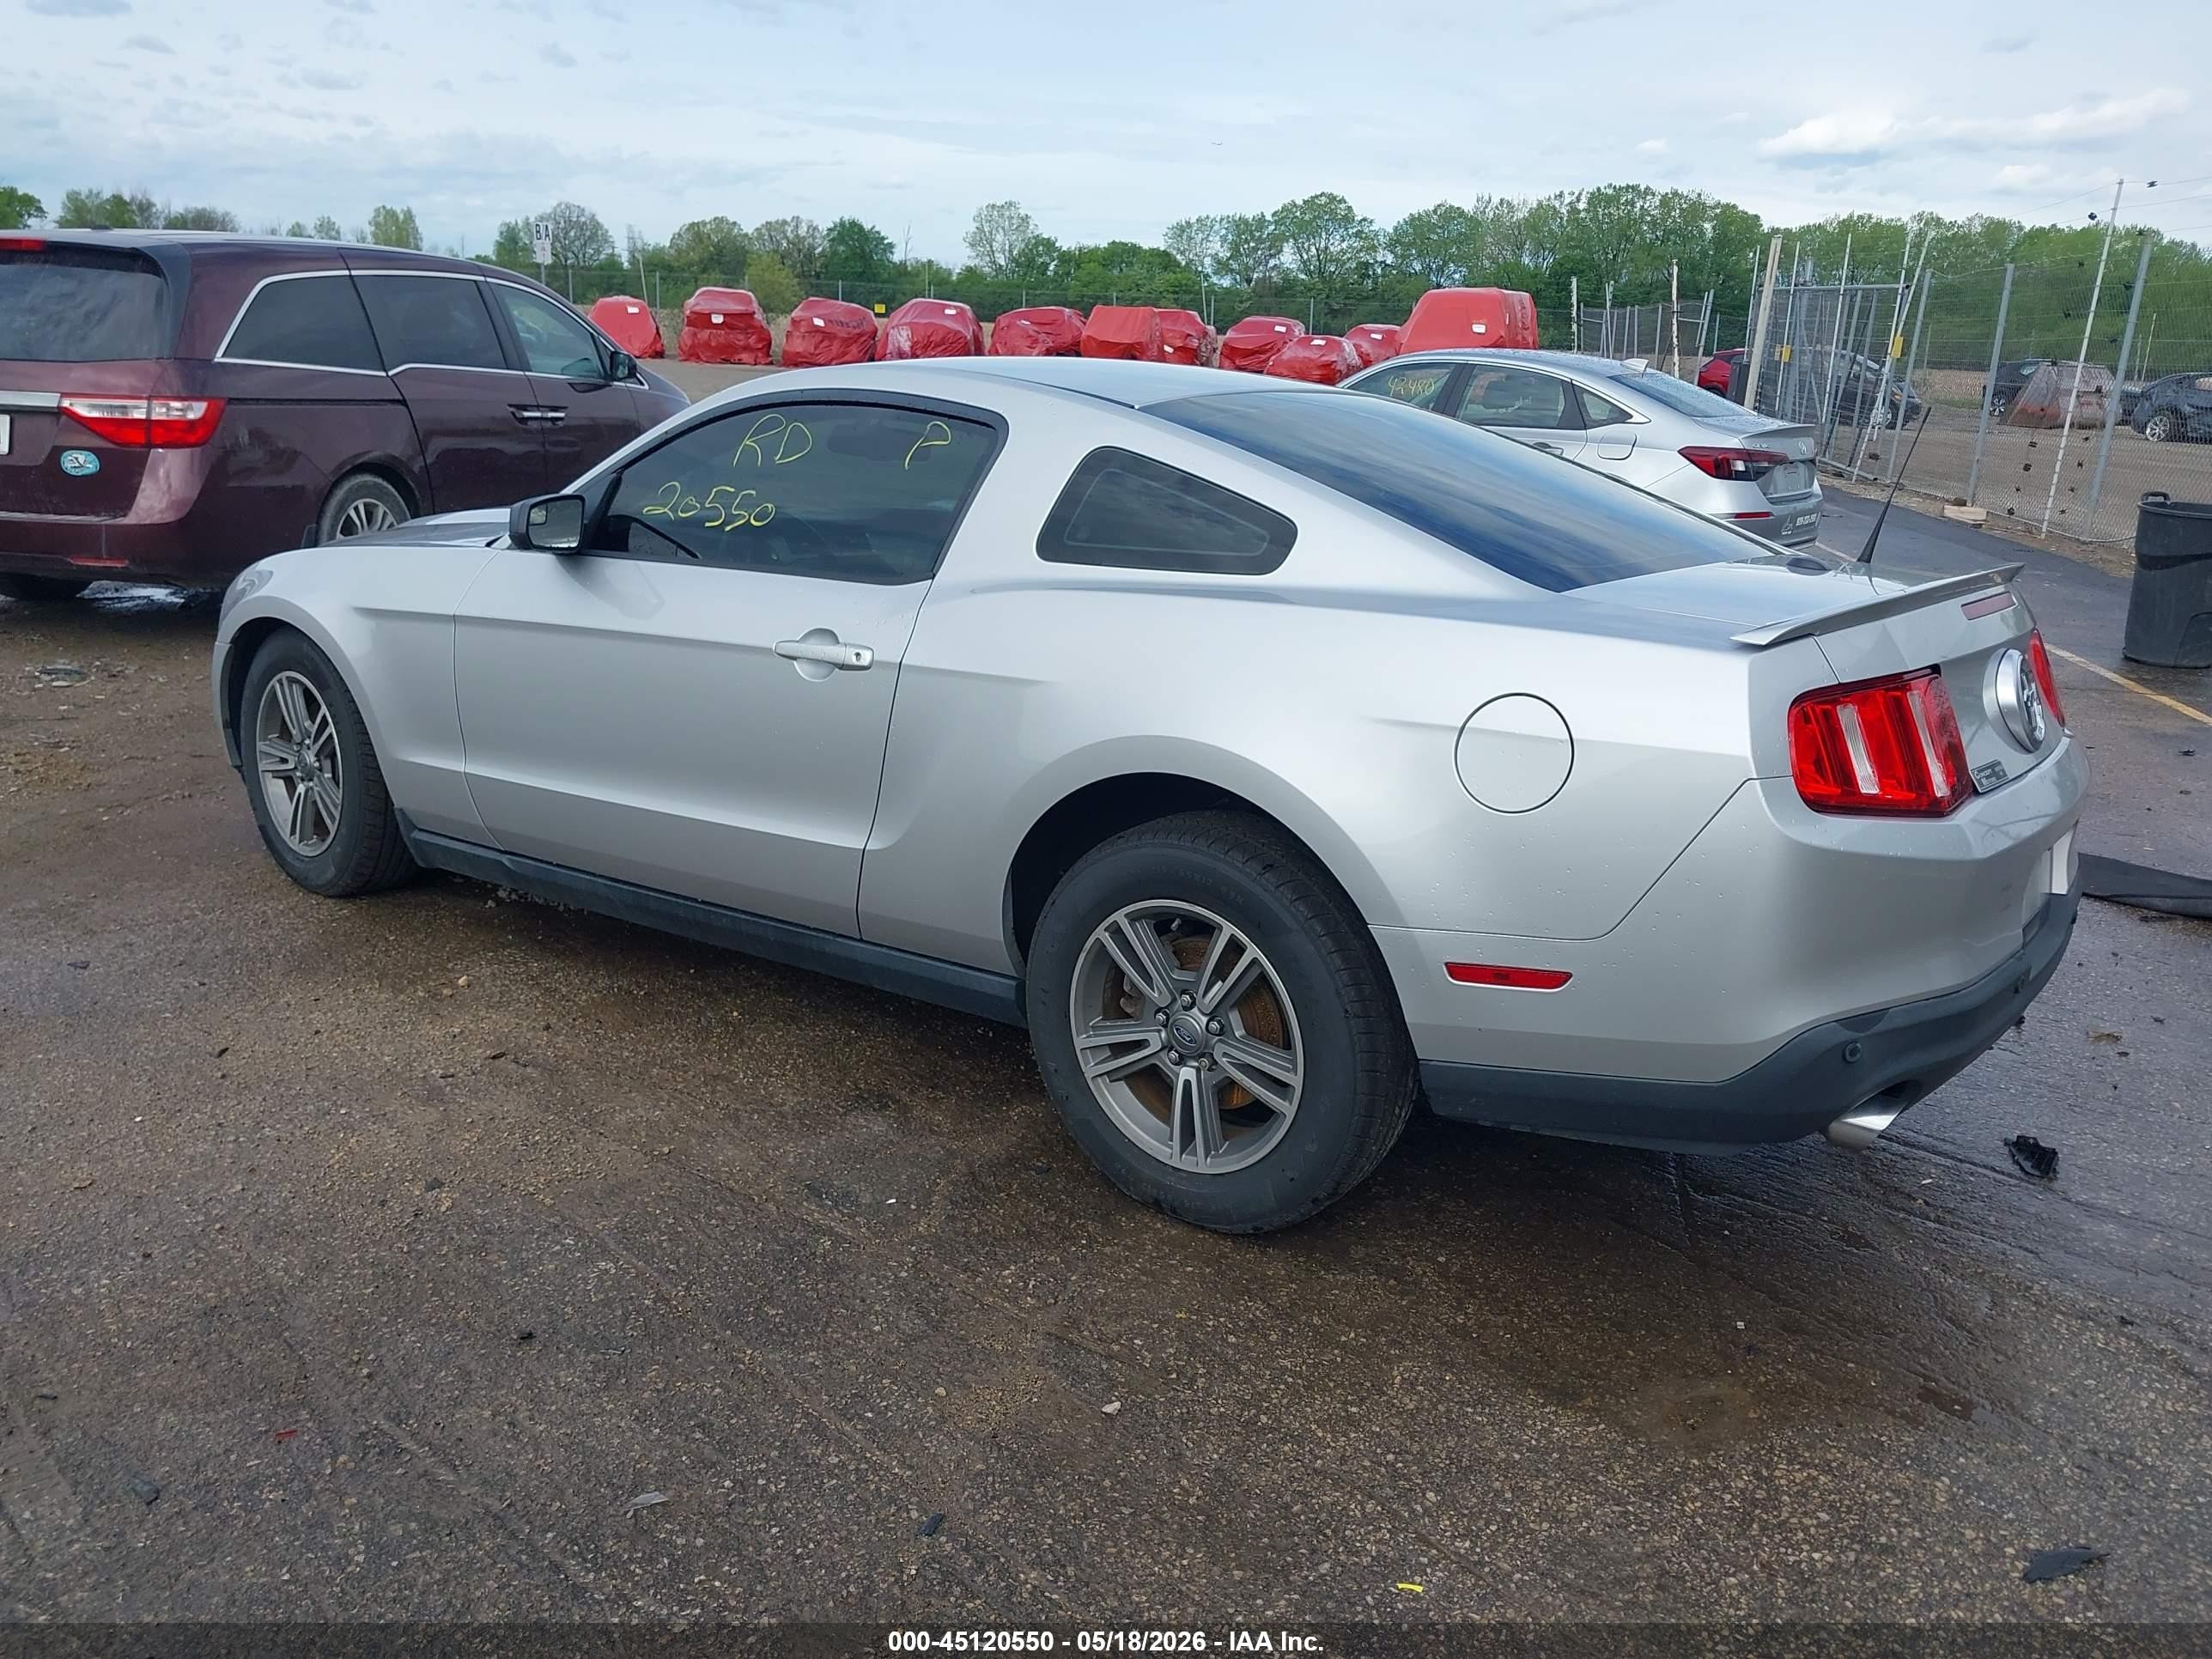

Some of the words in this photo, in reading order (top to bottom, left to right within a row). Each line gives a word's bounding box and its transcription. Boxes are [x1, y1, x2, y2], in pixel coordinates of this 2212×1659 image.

[733, 414, 813, 468] RD
[904, 420, 952, 471] P
[642, 481, 776, 532] 20550
